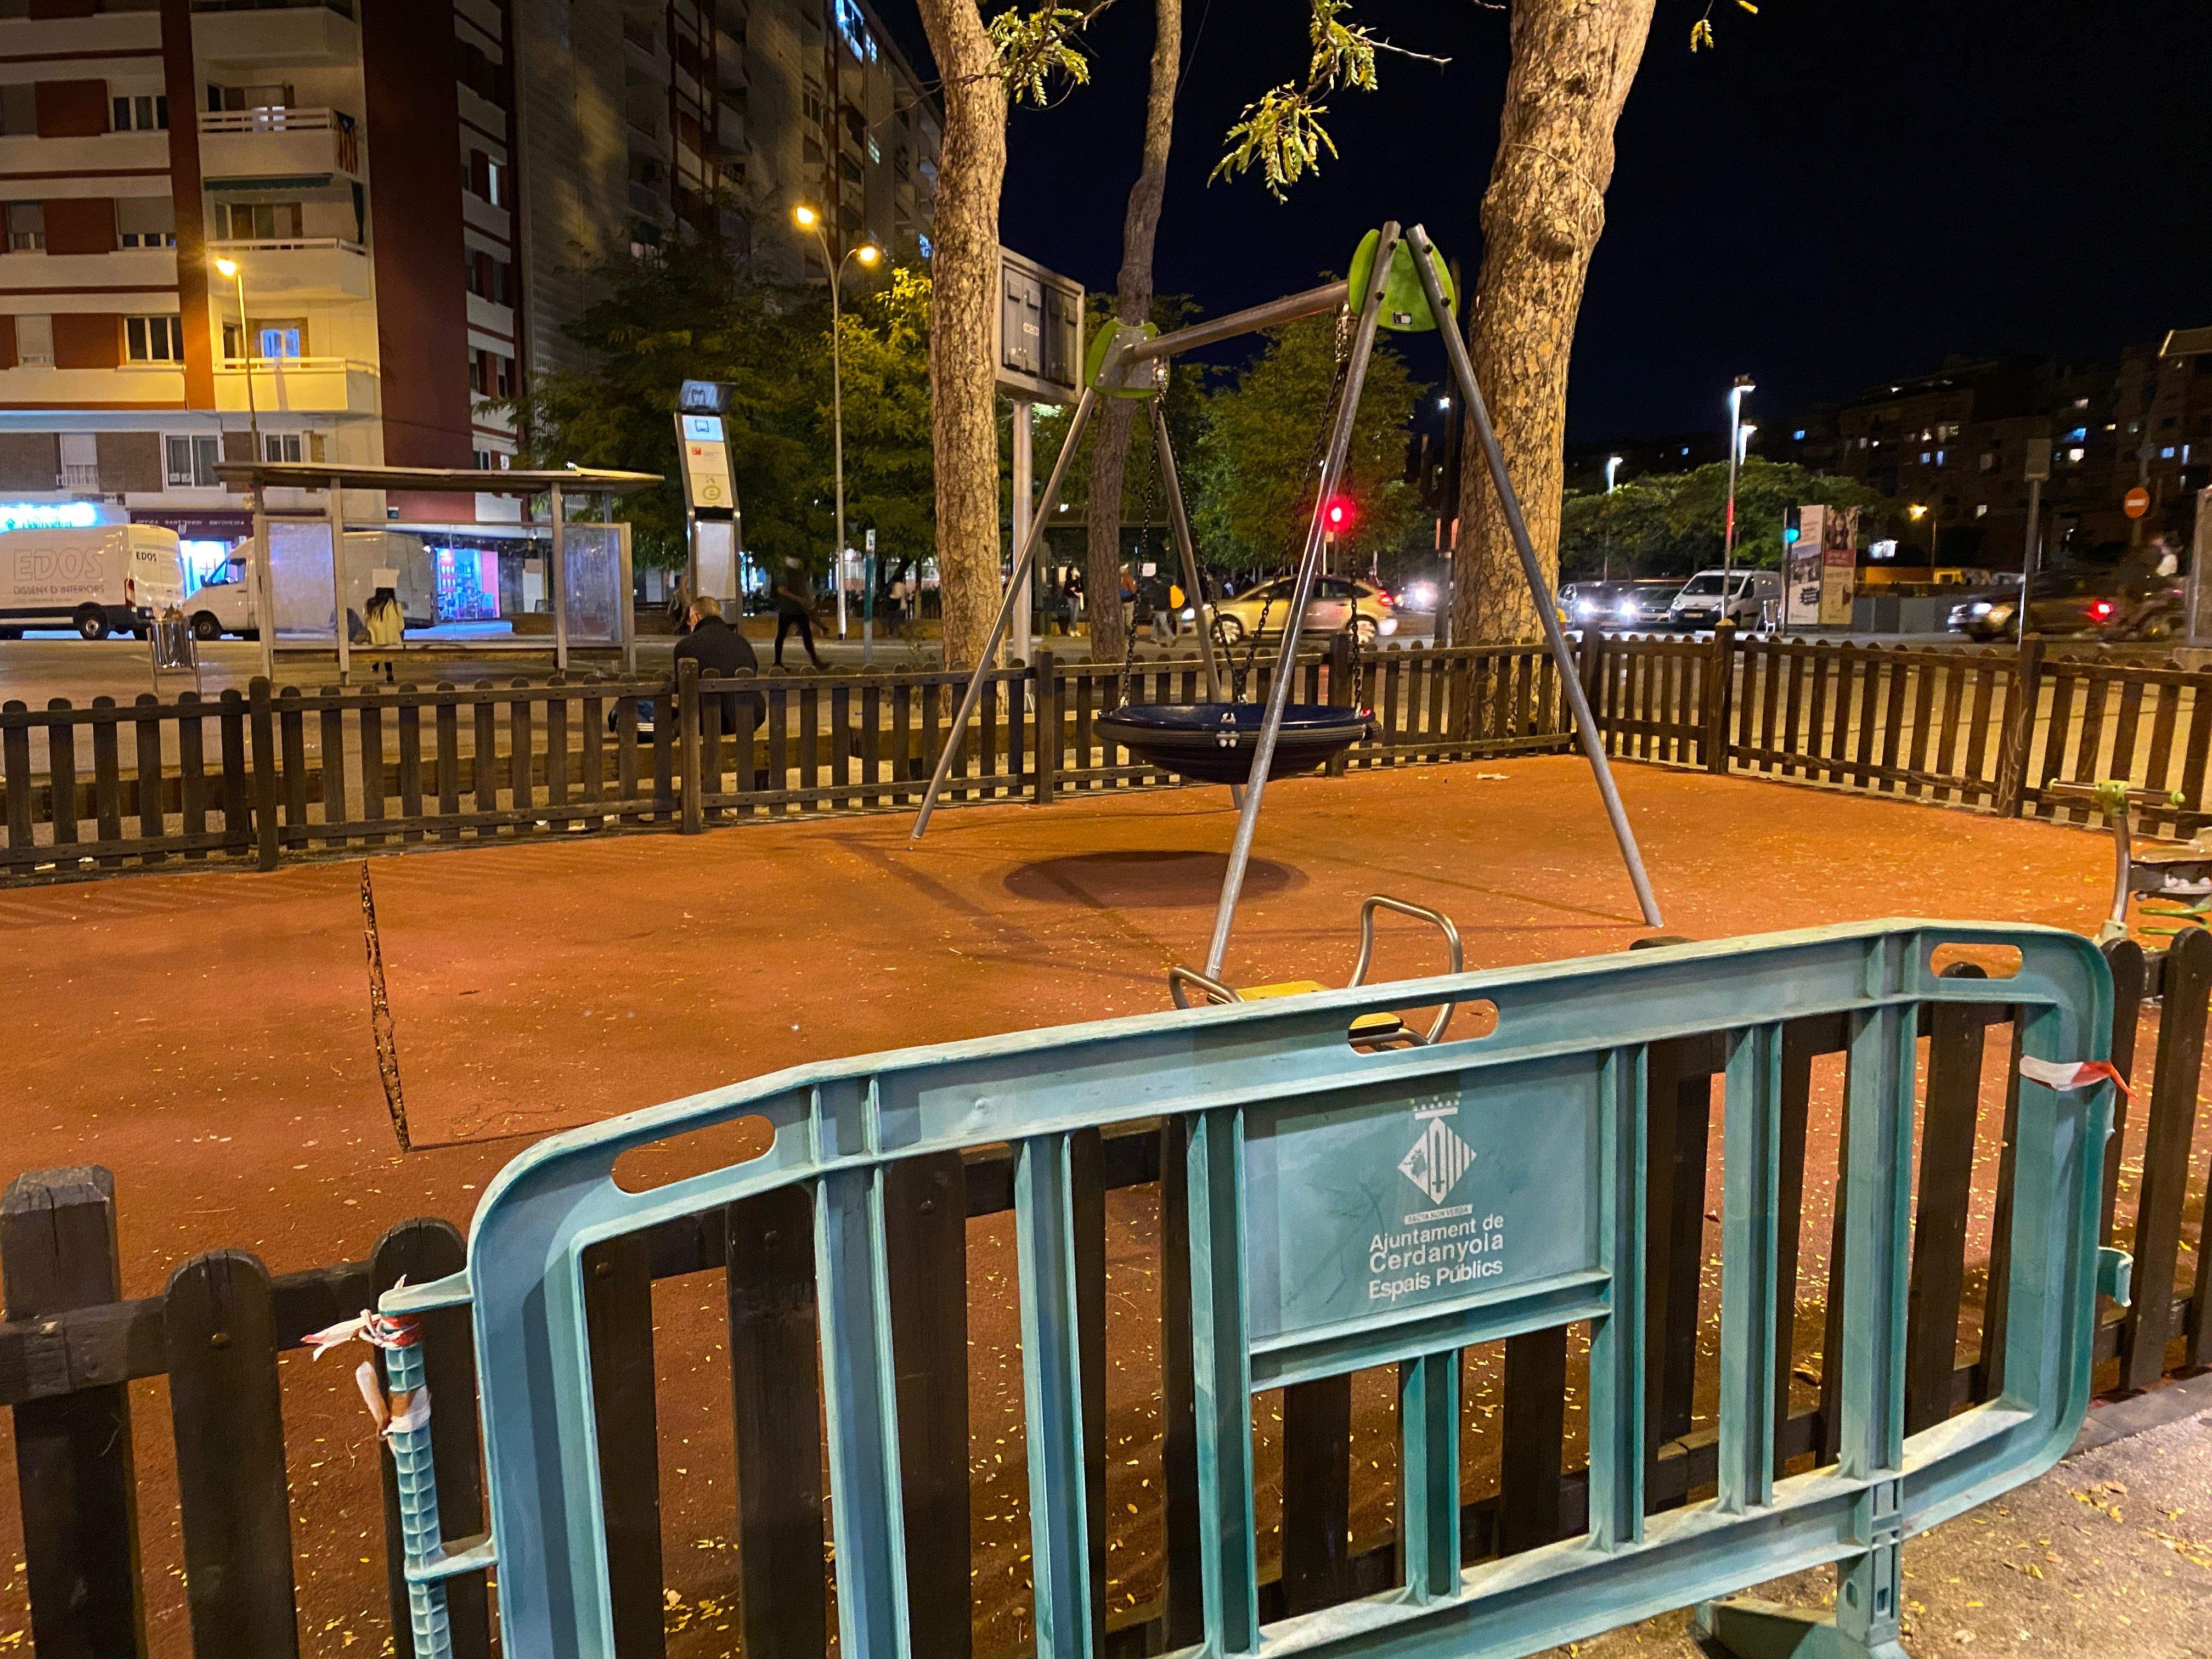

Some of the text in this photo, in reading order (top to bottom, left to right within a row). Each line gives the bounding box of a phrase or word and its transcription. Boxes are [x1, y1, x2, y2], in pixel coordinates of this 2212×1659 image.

[14, 548, 103, 581] EDOS
[136, 551, 157, 562] EDOS
[13, 585, 48, 595] DISSENY
[1370, 1214, 1504, 1254] Ajuntament de
[1370, 1233, 1504, 1273] Cerdanyola
[1369, 1260, 1503, 1301] Espais Públics
